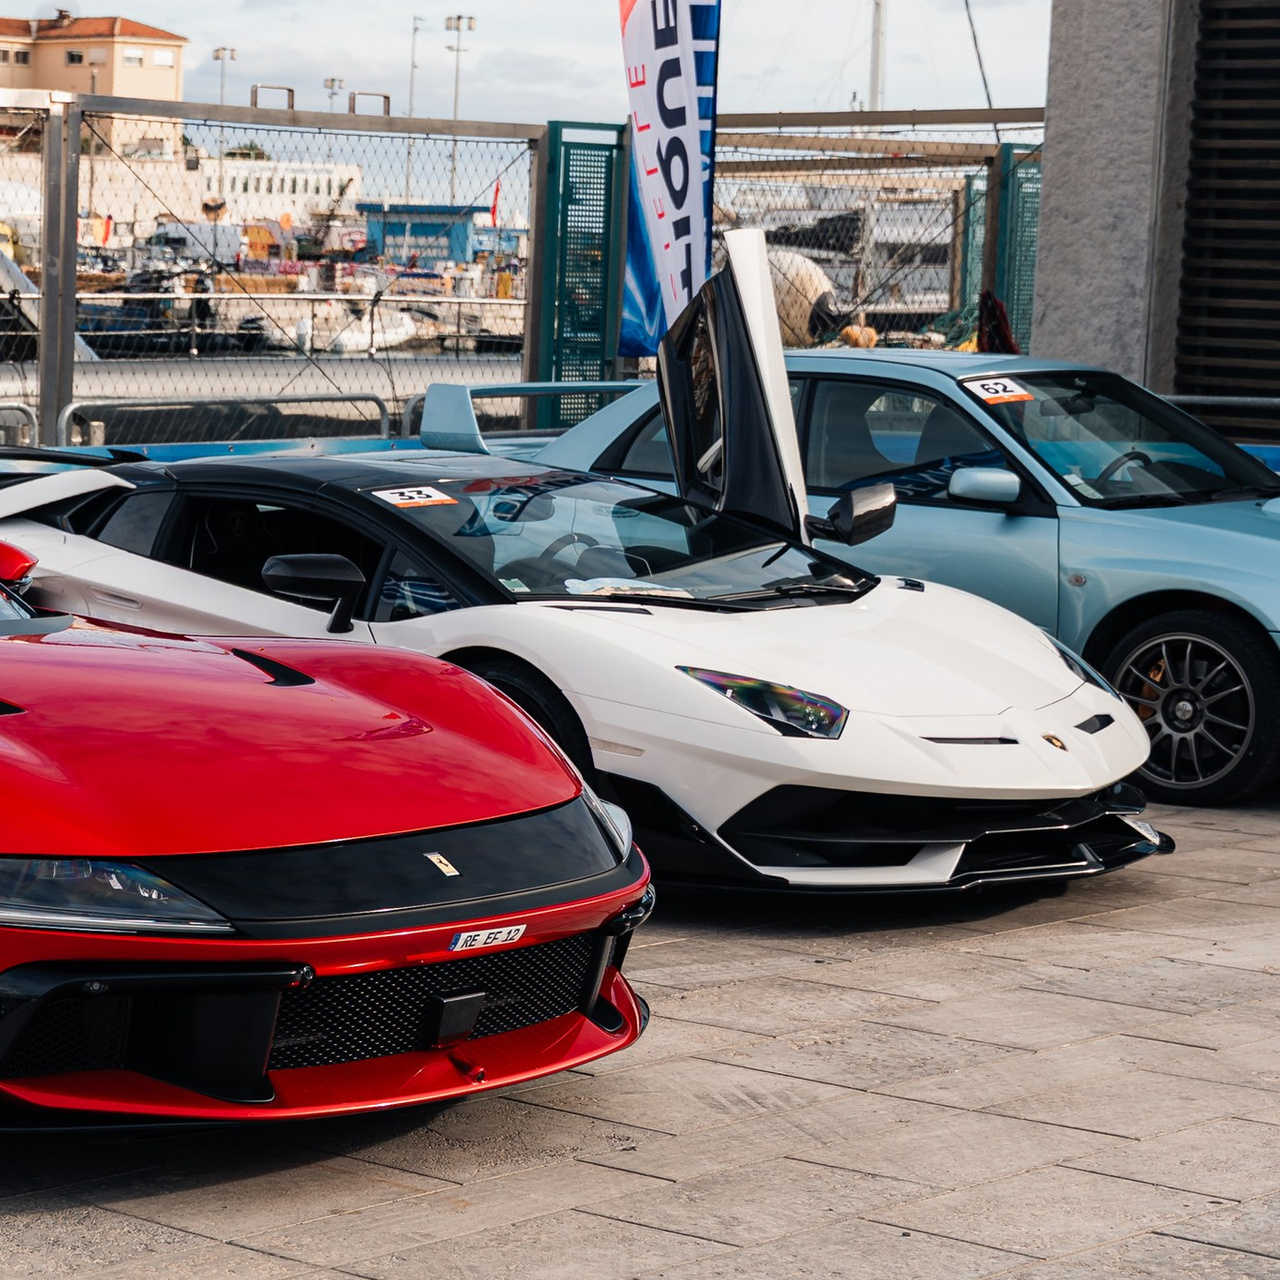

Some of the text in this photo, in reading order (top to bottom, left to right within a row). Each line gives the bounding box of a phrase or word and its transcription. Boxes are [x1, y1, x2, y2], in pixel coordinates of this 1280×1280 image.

[980, 382, 1015, 395] 62
[389, 489, 433, 501] 33
[460, 928, 521, 949] RE EF 12
